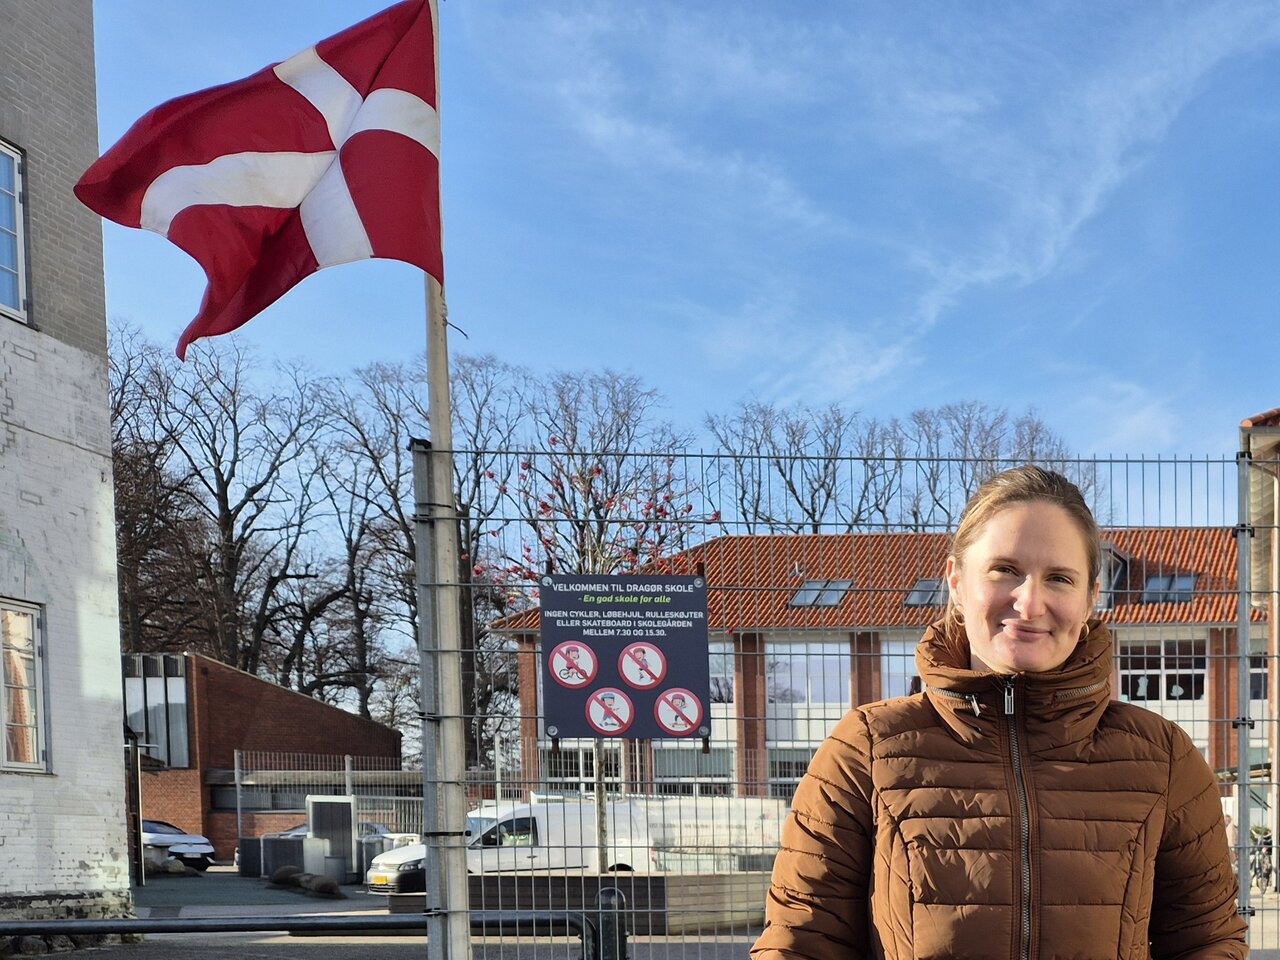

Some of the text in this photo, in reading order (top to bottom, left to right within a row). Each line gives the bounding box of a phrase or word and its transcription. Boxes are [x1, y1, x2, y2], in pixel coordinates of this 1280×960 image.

[552, 583, 694, 593] VELKOMMEN TIL DRAGØR SKOLE
[596, 595, 613, 603] god
[614, 595, 638, 603] skole
[639, 595, 652, 604] for
[569, 610, 601, 618] CYKLER,
[602, 610, 644, 619] LØBEHJUL,
[645, 611, 704, 619] RULLESKØJTER
[637, 619, 692, 628] SKOLEGÅRDEN
[645, 629, 666, 637] 15.30.
